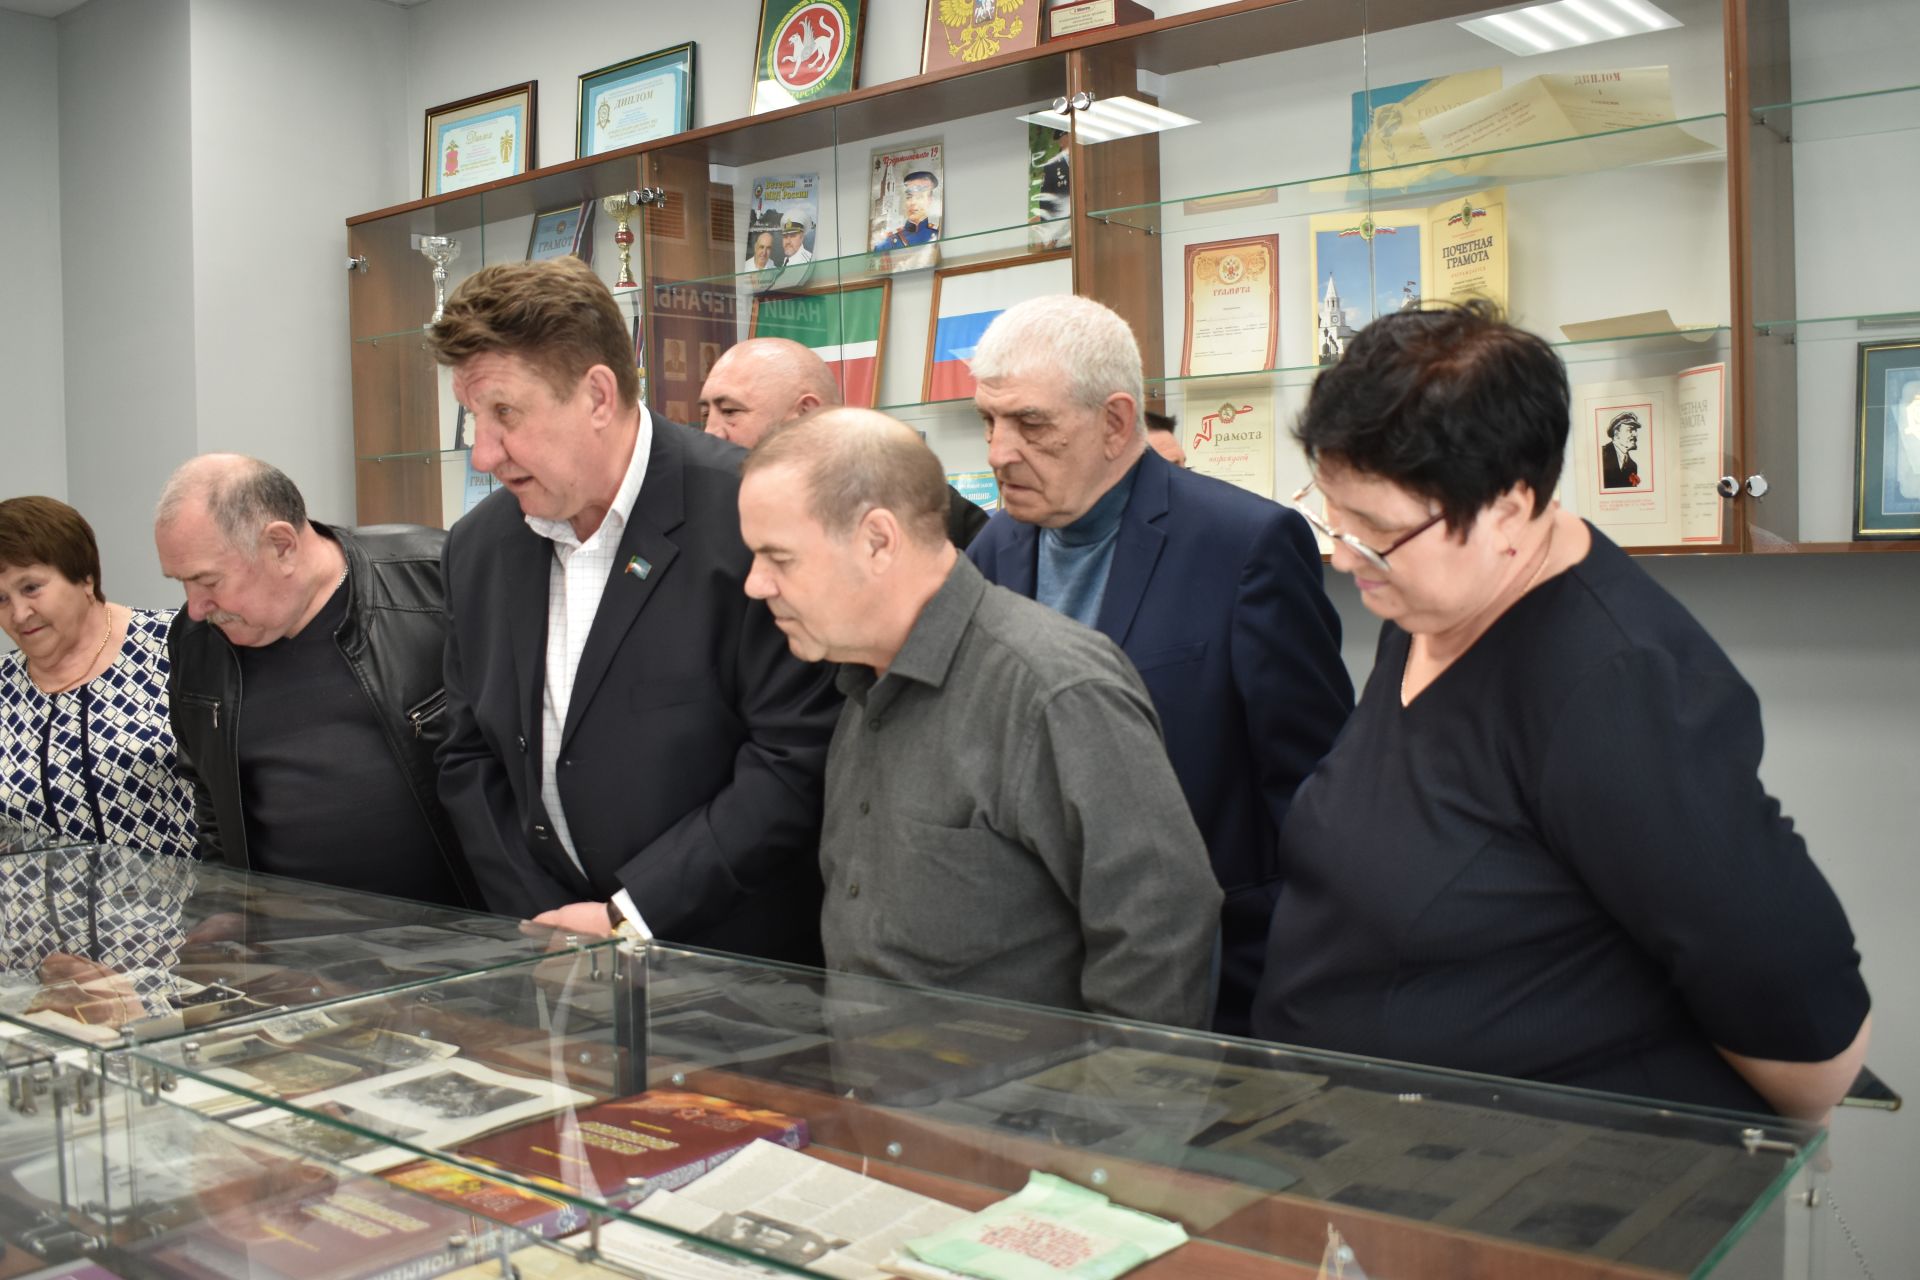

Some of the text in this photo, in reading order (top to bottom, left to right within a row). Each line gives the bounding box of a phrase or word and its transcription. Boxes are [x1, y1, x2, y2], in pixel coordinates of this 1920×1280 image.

[613, 90, 654, 110] ДИПЛОМ
[537, 235, 574, 253] ГРАМОТ
[1442, 236, 1493, 258] ПОЧЕТНАЯ
[1446, 250, 1490, 269] ГРАМОТА
